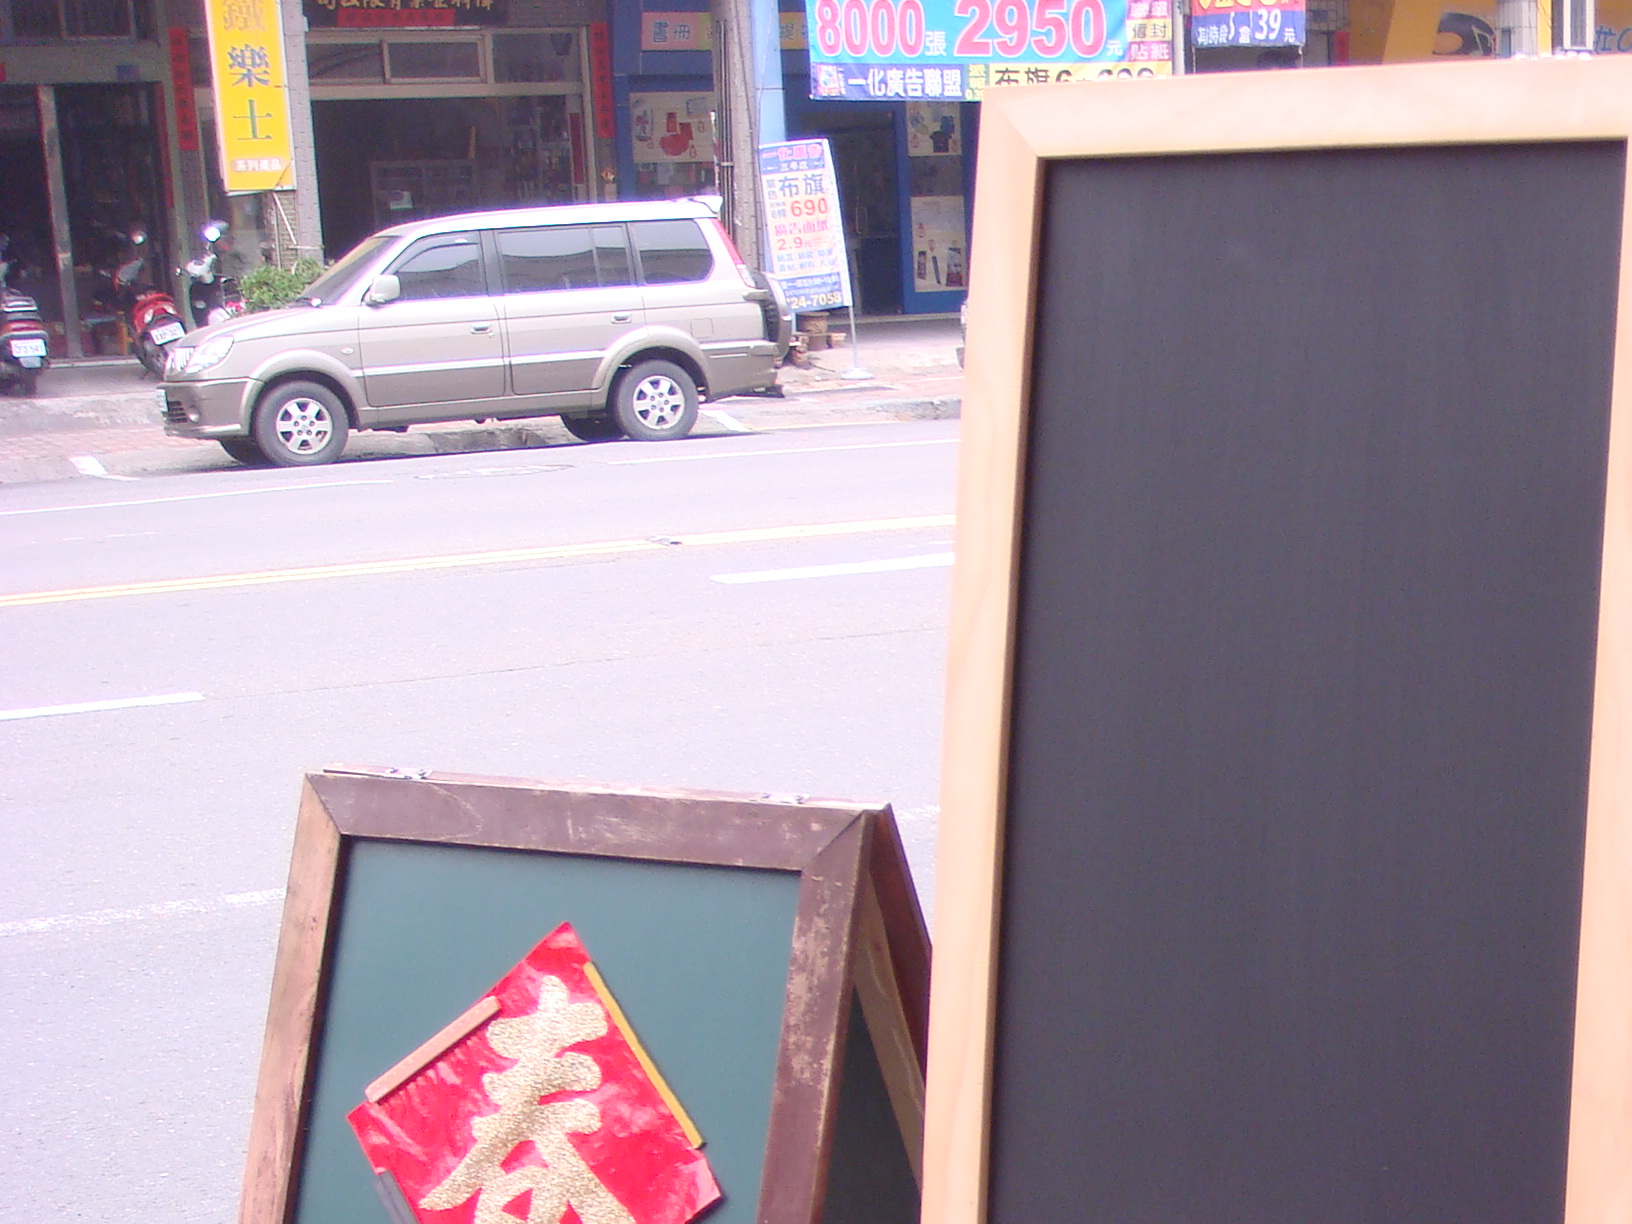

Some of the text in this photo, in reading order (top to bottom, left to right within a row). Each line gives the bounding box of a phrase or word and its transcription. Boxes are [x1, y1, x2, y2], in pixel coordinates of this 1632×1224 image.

[653, 21, 690, 42] 書冊
[1132, 23, 1168, 40] 信封
[1130, 43, 1169, 61] 貼紙
[848, 68, 963, 98] 一化廣告聯盟
[778, 174, 825, 198] 布旗
[790, 198, 828, 217] 690
[787, 294, 842, 309] 24-7058
